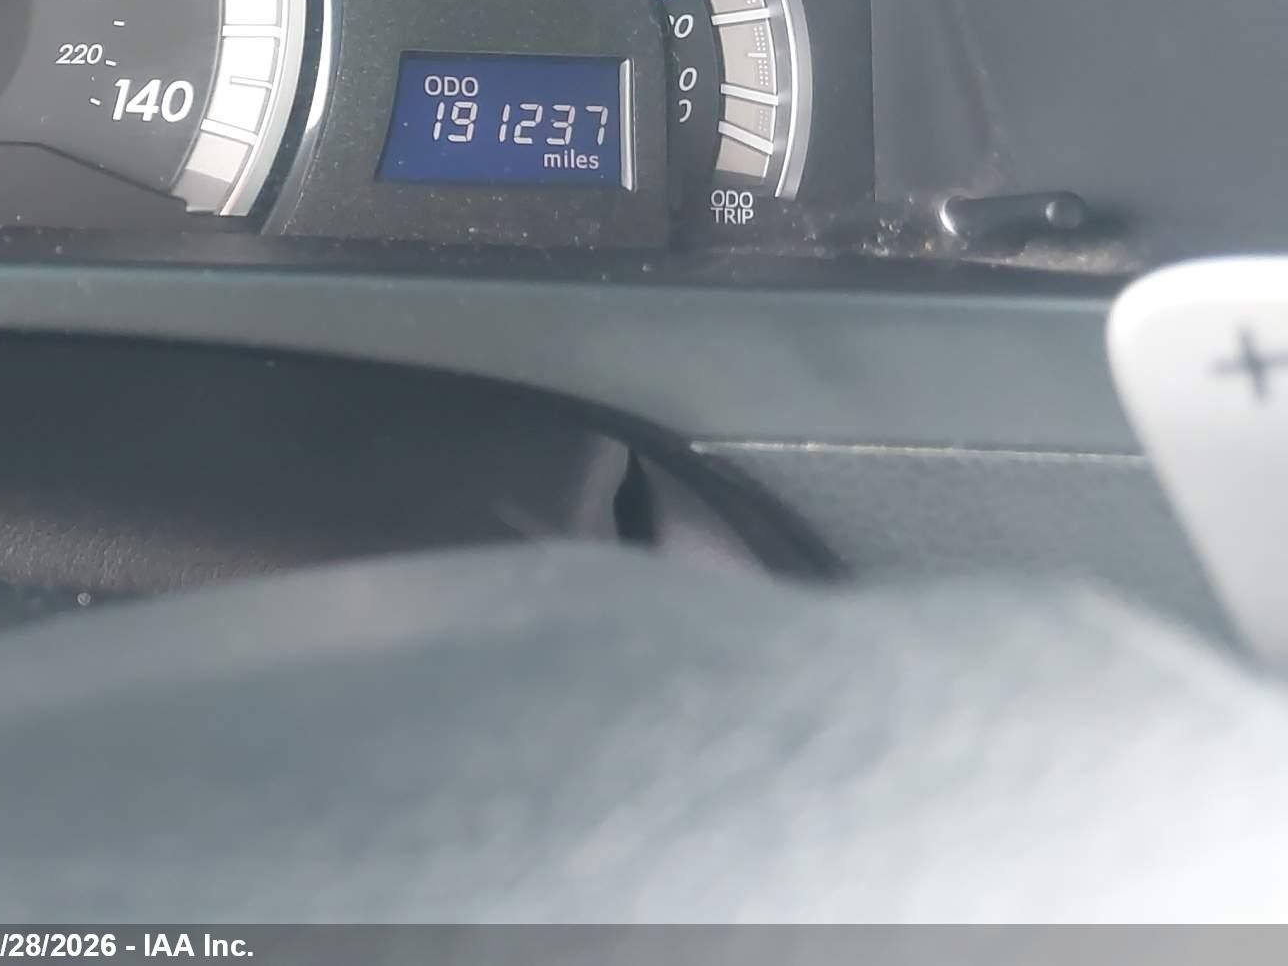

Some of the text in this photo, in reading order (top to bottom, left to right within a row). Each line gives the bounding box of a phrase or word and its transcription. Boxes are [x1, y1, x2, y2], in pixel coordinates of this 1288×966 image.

[56, 44, 102, 65] 220
[425, 76, 479, 96] ODO
[113, 79, 193, 122] 140
[433, 102, 608, 145] 191237
[544, 149, 599, 169] miles
[711, 190, 753, 208] ODO
[711, 207, 753, 224] TRIP
